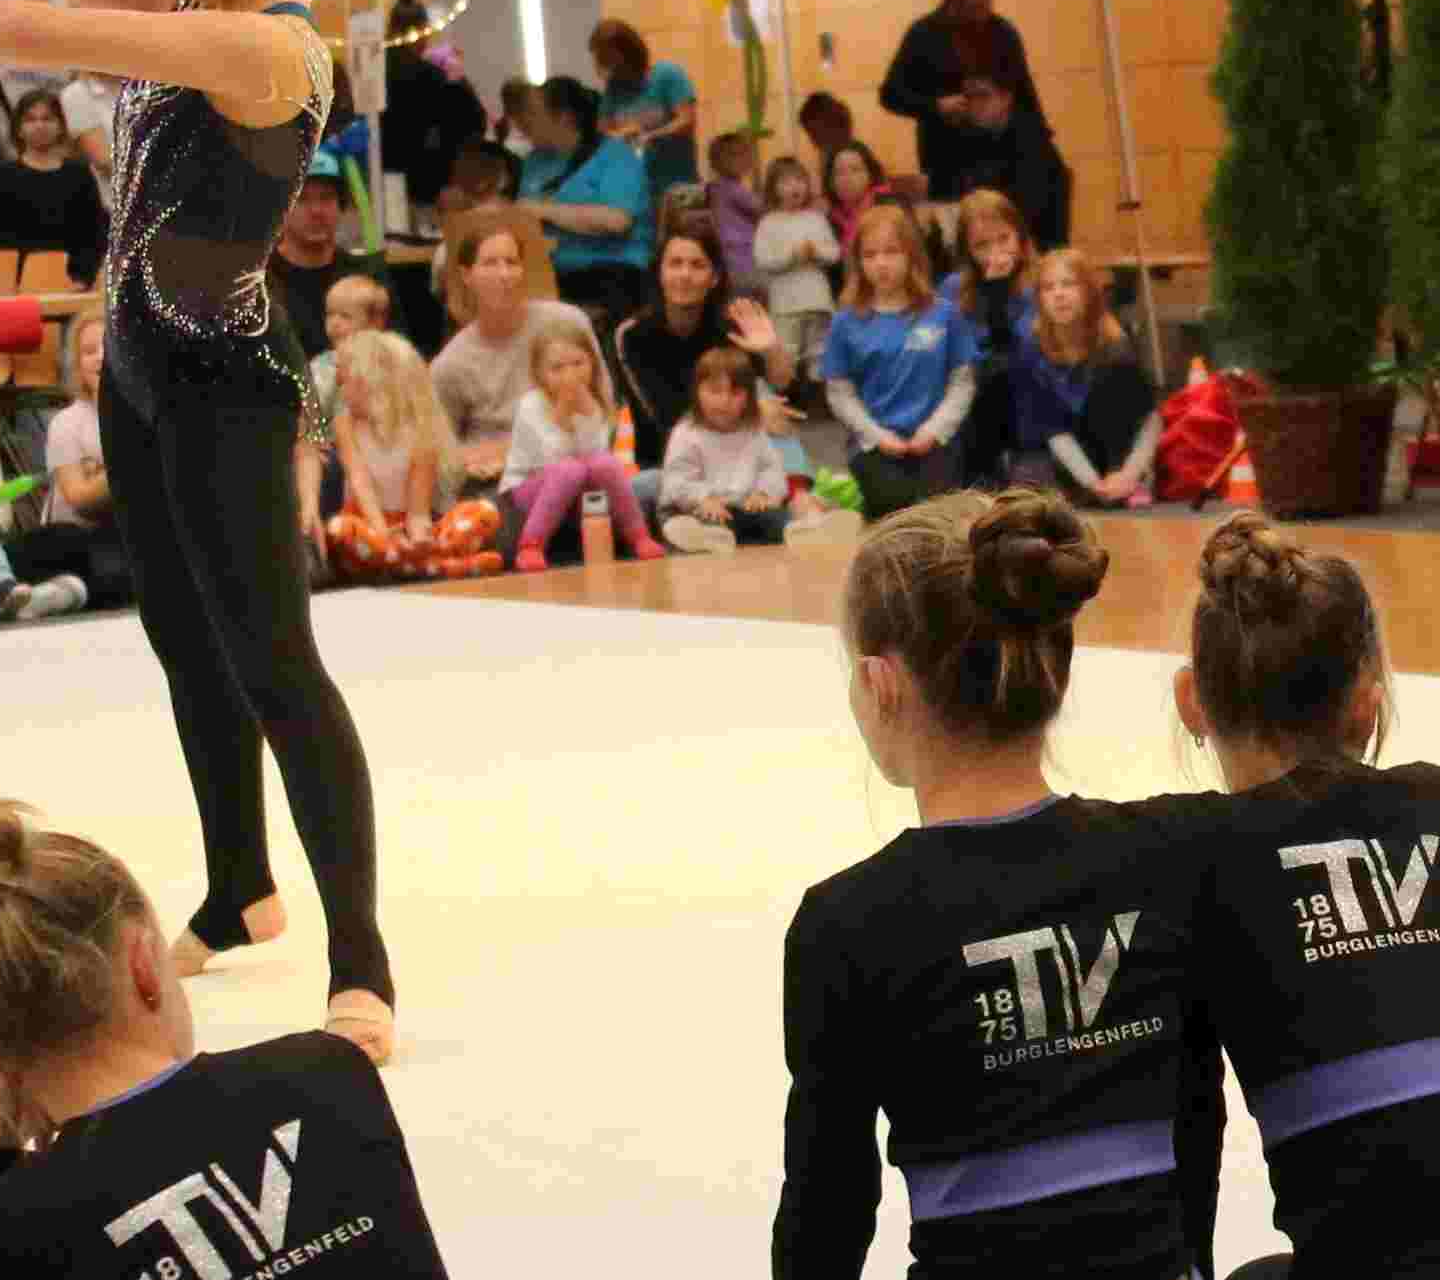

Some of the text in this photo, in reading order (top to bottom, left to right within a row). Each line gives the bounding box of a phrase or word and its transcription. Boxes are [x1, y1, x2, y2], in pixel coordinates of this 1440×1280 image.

[1277, 834, 1440, 934] TV
[1293, 893, 1330, 919] 18
[1297, 916, 1338, 942] 75
[963, 910, 1141, 1041] TV
[974, 988, 1013, 1017] 18
[979, 1017, 1017, 1045] 75
[983, 1016, 1163, 1070] BURGLENGENFELD
